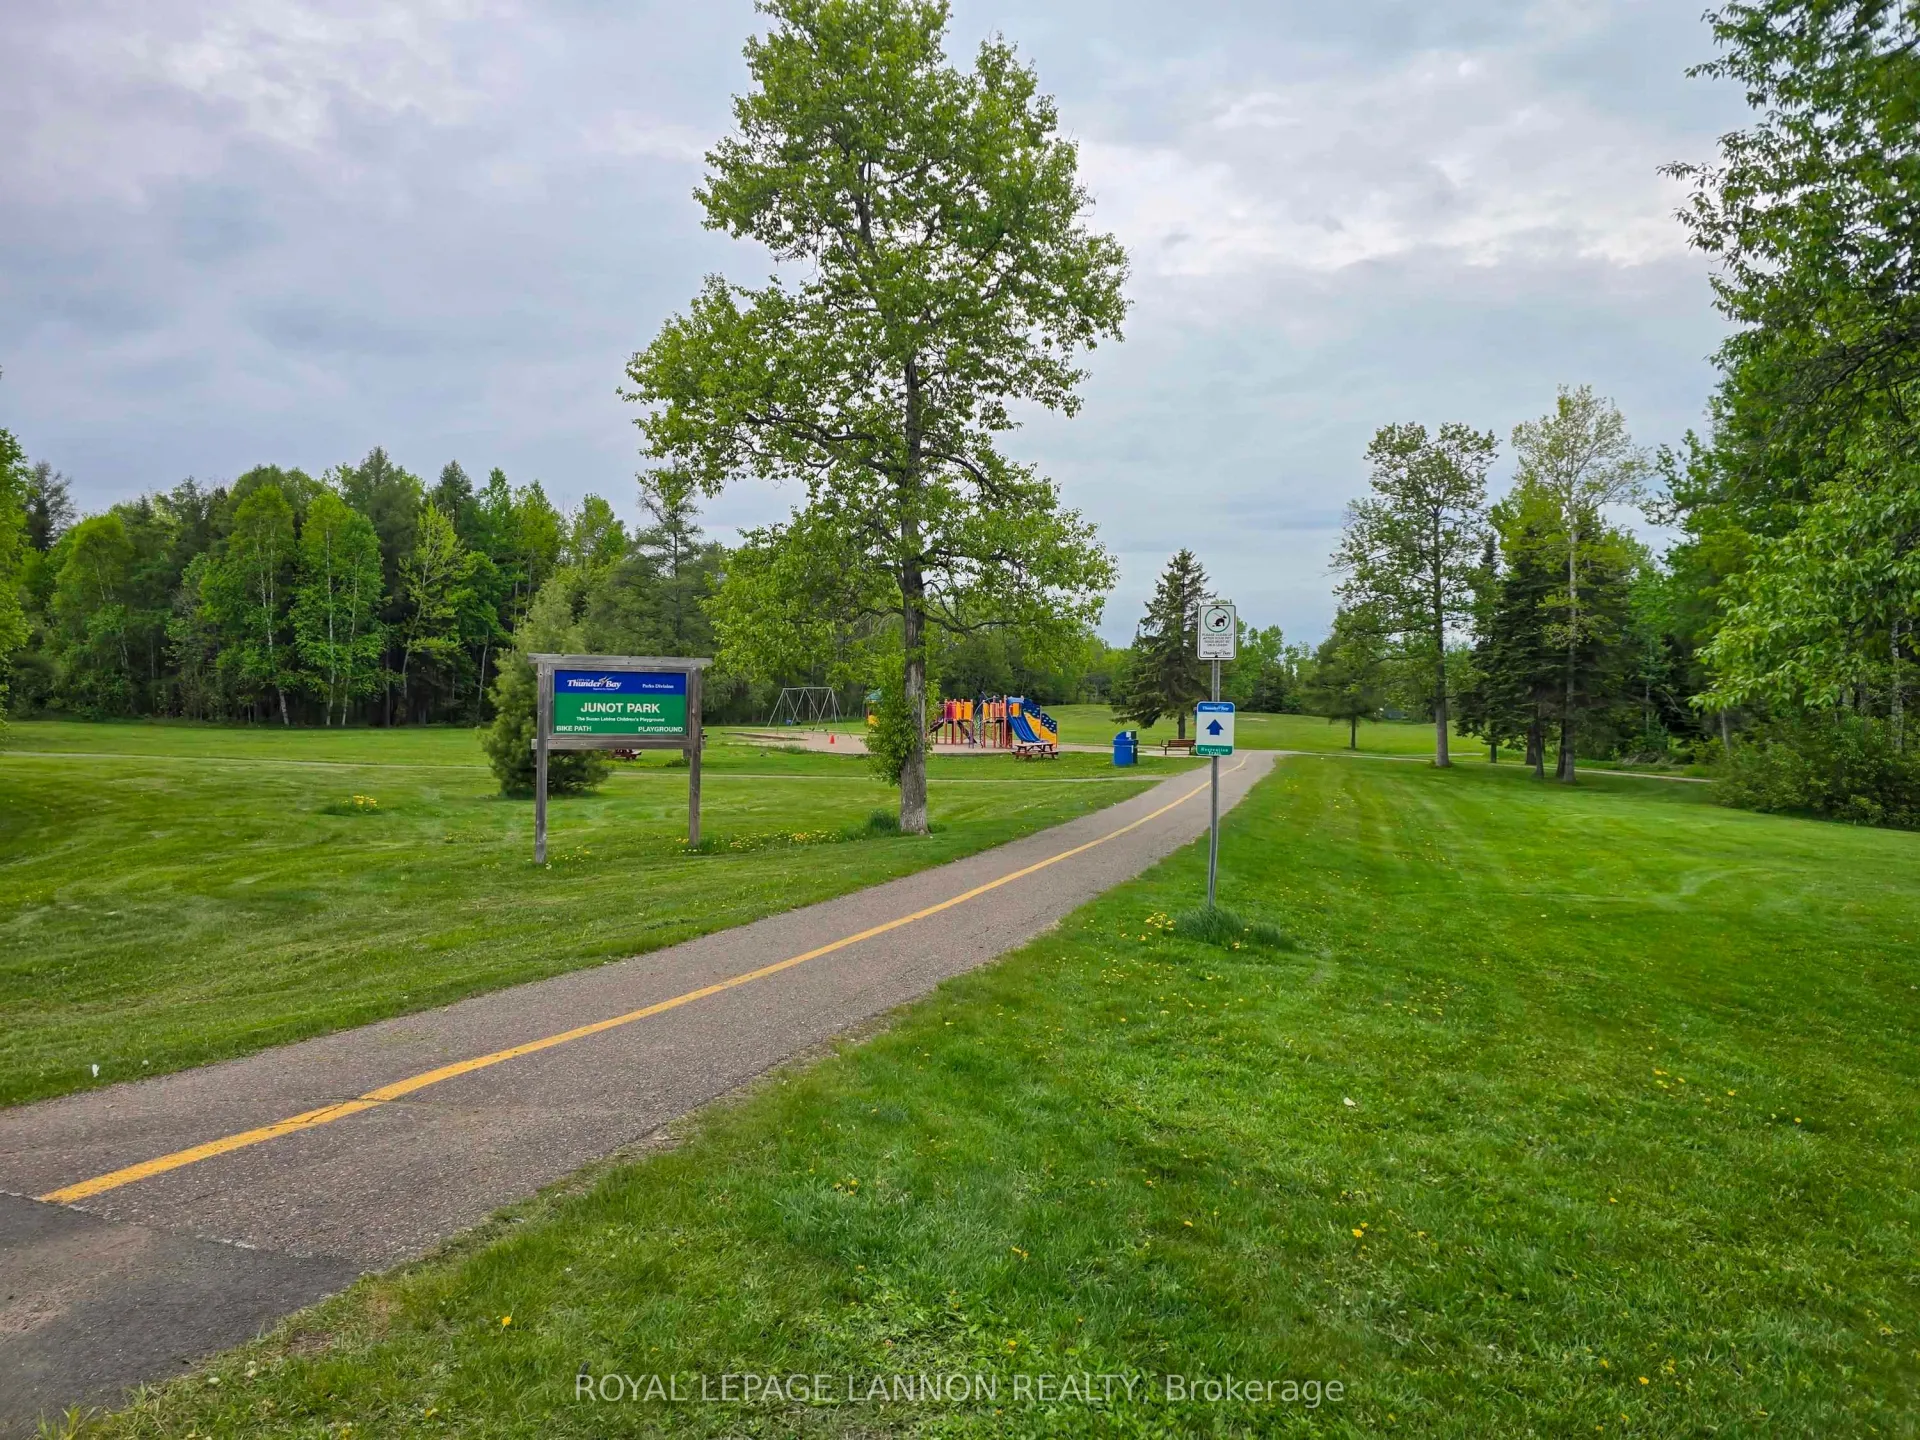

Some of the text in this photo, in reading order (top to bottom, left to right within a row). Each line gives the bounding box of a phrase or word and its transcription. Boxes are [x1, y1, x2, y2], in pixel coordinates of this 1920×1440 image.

[567, 679, 601, 688] Thunder
[605, 680, 622, 690] Bay
[580, 703, 660, 714] JUNOT PARK
